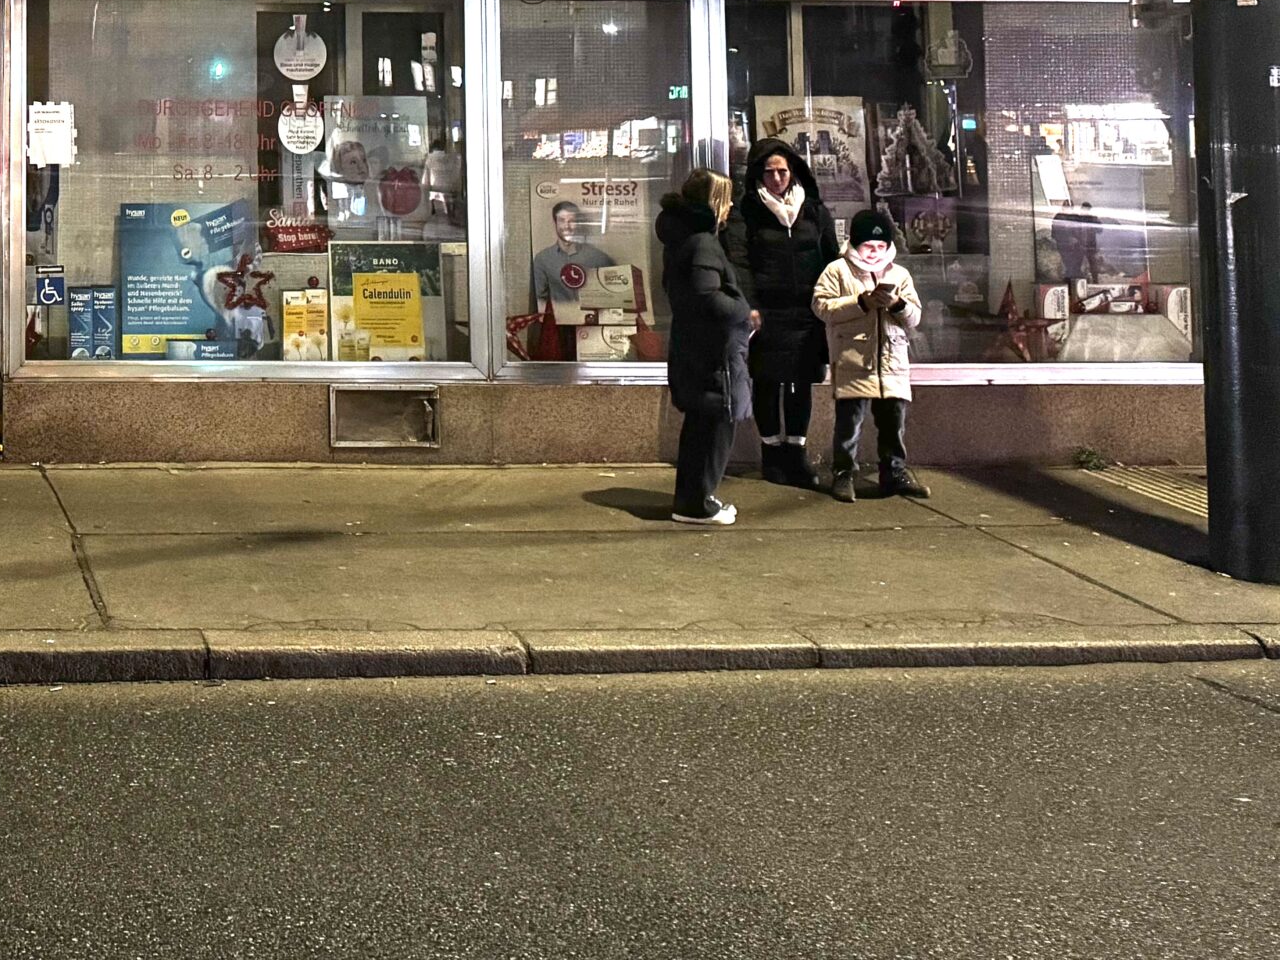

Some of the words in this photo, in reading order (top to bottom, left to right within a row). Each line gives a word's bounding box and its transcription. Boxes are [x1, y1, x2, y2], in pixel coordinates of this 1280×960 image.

[294, 153, 304, 199] epanthen
[581, 181, 638, 196] Stress?
[582, 198, 597, 206] Nur
[599, 198, 612, 206] de
[278, 233, 297, 243] Stop
[362, 288, 412, 299] Calendulin
